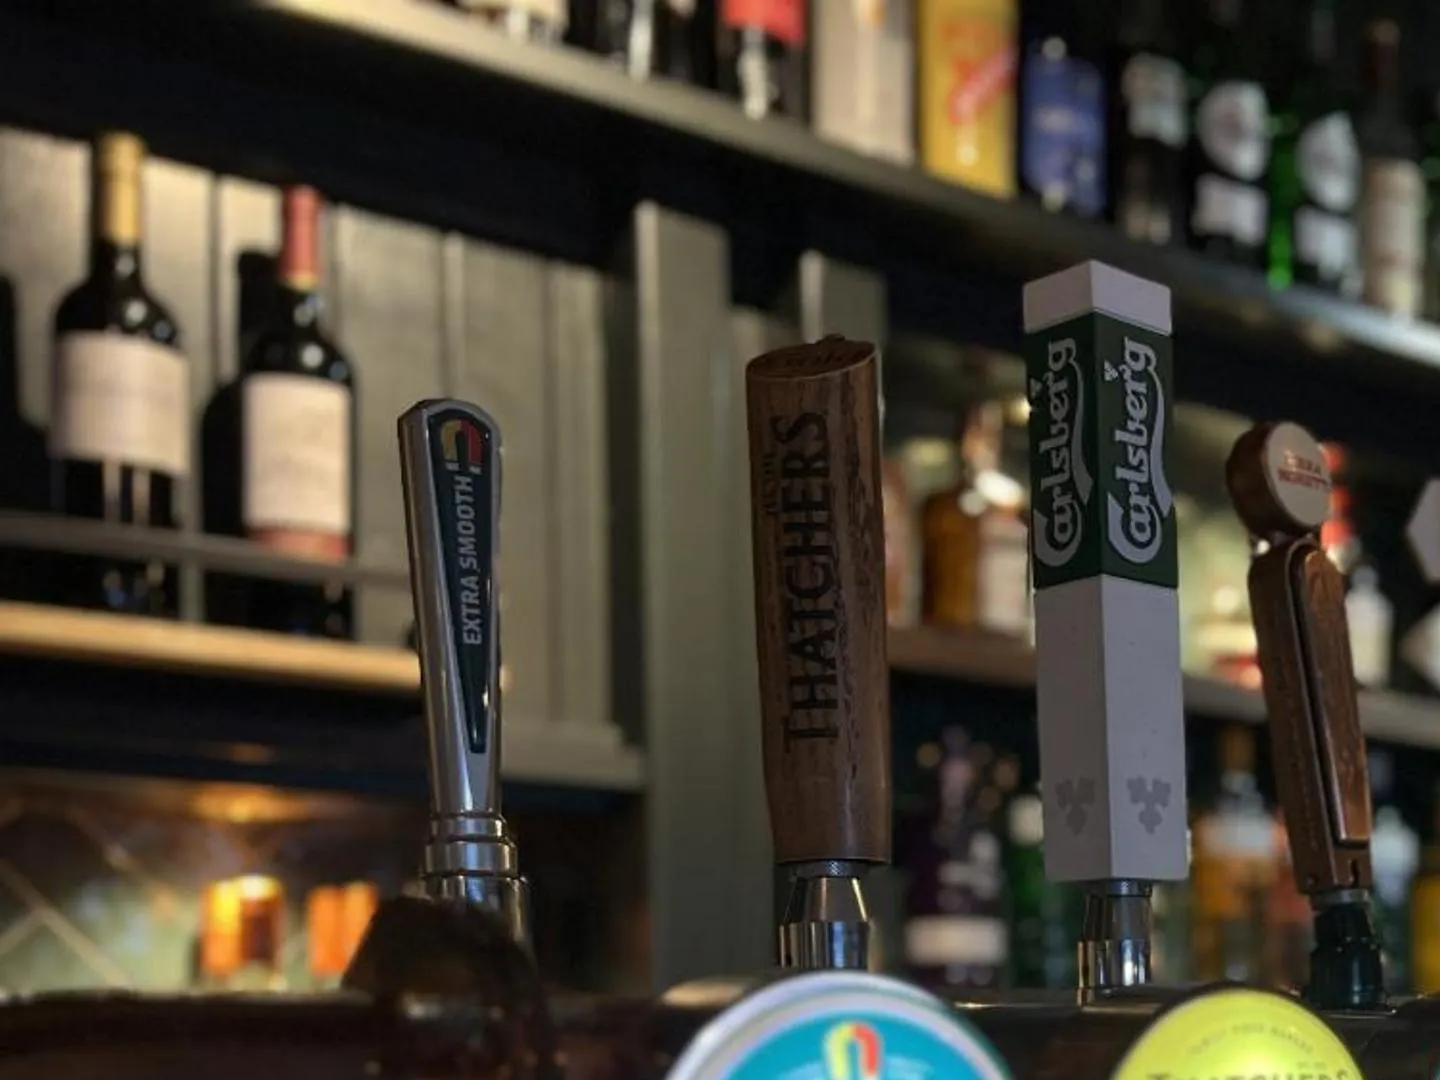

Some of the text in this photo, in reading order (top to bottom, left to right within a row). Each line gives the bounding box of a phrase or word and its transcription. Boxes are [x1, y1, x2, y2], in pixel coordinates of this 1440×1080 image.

[453, 474, 482, 646] EXTRA SMOOTH
[1032, 337, 1083, 567] Carlsberg
[1107, 336, 1162, 564] Carlsberg
[770, 412, 840, 752] THATCHERS
